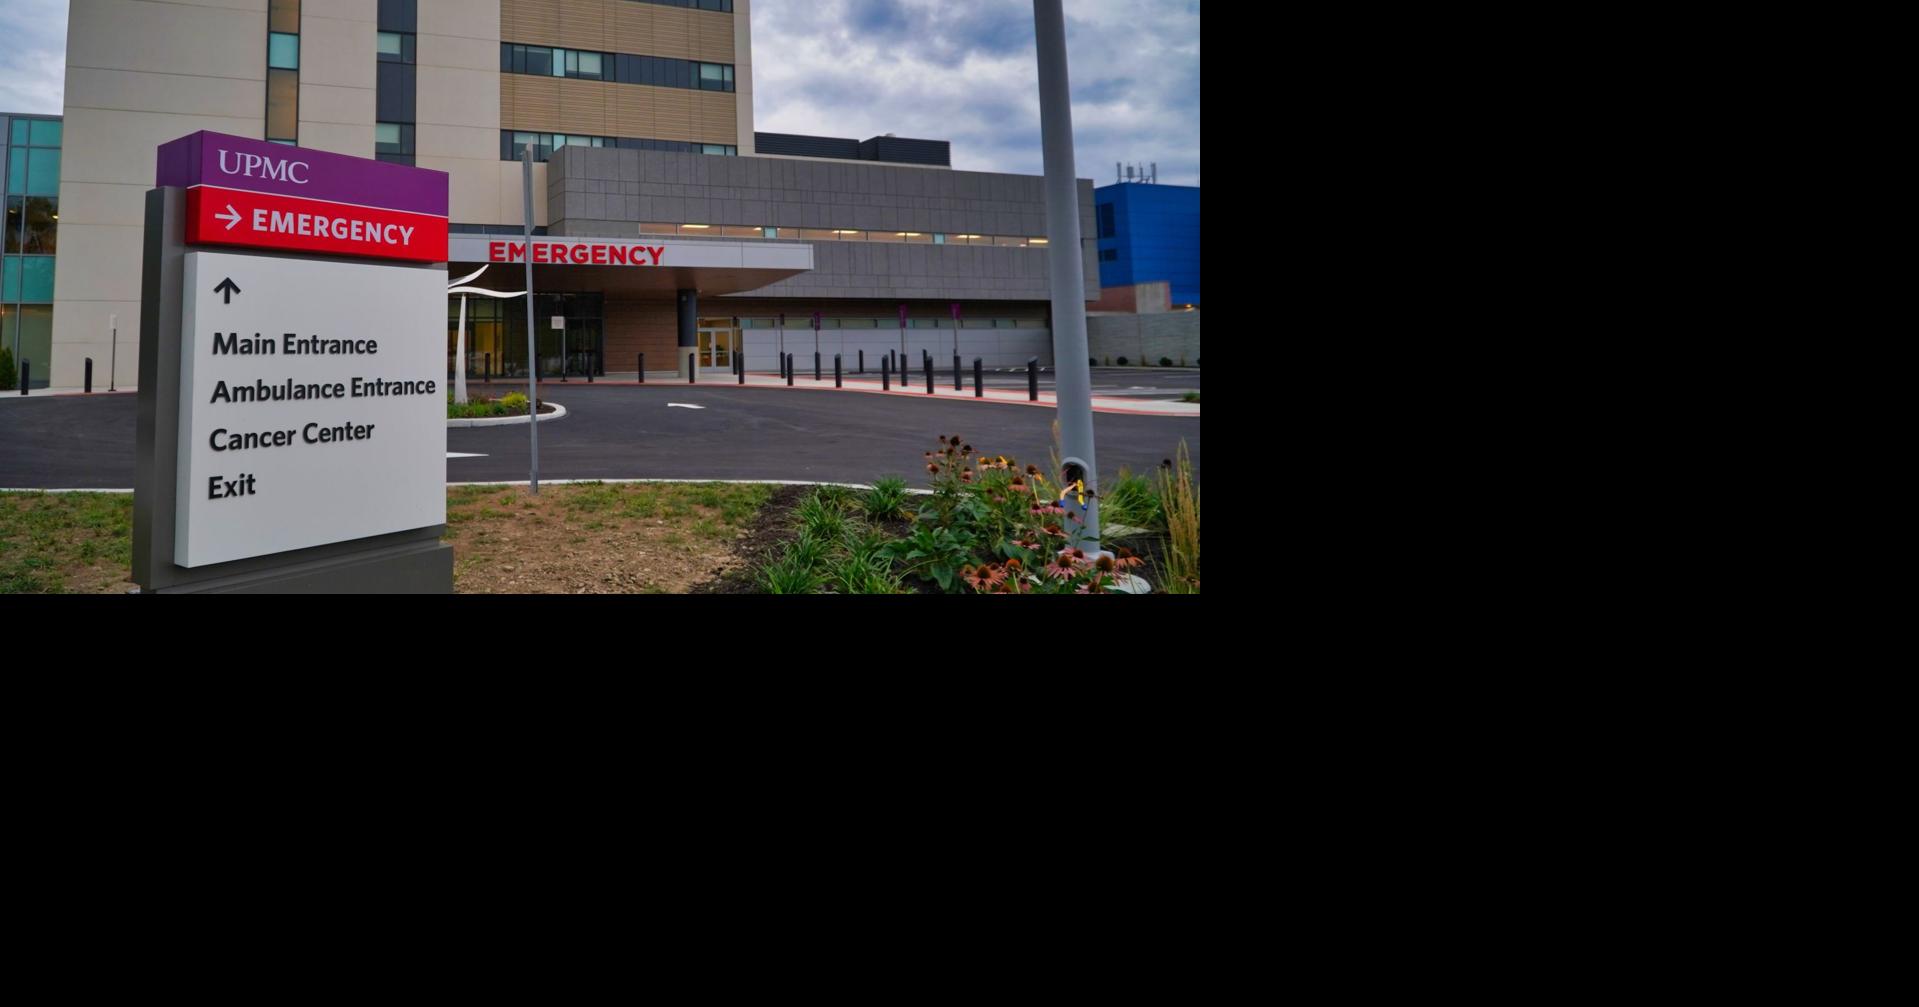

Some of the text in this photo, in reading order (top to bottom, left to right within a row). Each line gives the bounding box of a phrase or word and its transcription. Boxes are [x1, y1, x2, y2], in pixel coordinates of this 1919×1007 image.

[218, 149, 309, 184] UPMC
[252, 208, 414, 246] EMERGENCY
[489, 241, 664, 265] EMERGENCY
[212, 332, 378, 355] Main Entrance
[210, 377, 436, 403] Ambulance Entrance
[209, 421, 375, 452] Cancer Center
[208, 473, 256, 500] Exit
